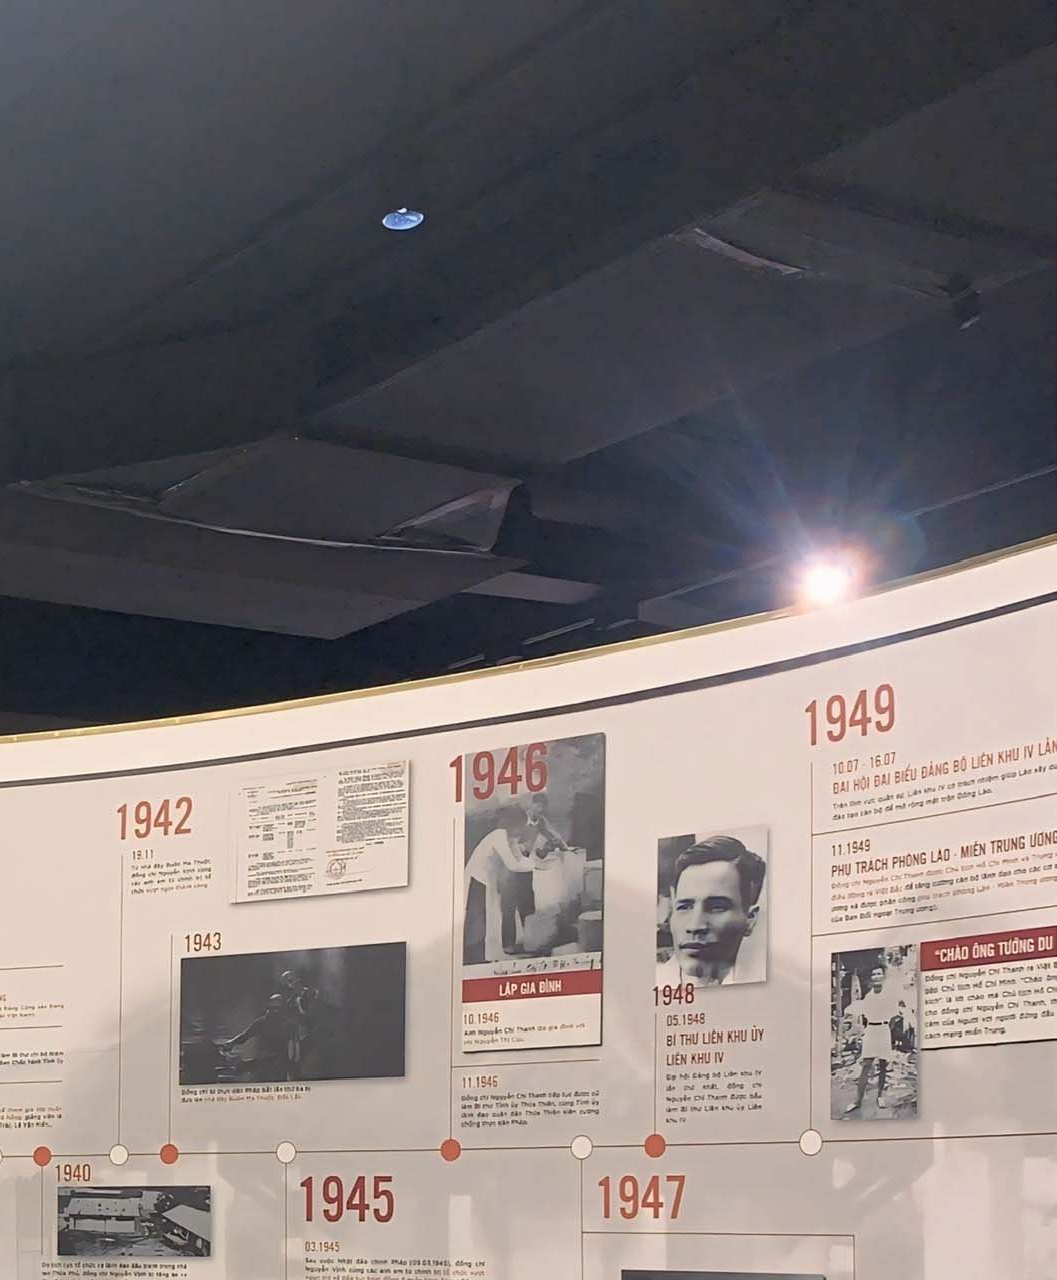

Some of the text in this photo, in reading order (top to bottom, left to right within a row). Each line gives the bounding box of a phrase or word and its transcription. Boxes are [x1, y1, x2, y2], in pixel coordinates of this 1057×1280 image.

[805, 683, 895, 746] 1949
[833, 759, 859, 775] 10.07
[870, 752, 896, 769] 16.07
[971, 752, 994, 769] LIÊN
[998, 747, 1020, 764] KHU
[1024, 744, 1034, 759] IV
[449, 742, 548, 803] 1946
[116, 796, 193, 841] 1942
[832, 839, 871, 857] 11.1949
[990, 835, 1026, 854] TRUNG
[184, 932, 222, 953] 1943
[972, 942, 995, 959] ÔNG
[998, 936, 1035, 956] TƯỚNG
[1038, 935, 1054, 952] DU
[499, 978, 562, 997] LẬP GIA ĐÌNH
[652, 982, 694, 1007] 1948
[464, 1012, 500, 1025] 10.1946
[666, 1012, 706, 1027] 05.1948
[666, 1024, 765, 1047] BÍ THƯ LIÊN KHU ỦY
[666, 1051, 725, 1066] LIÊN KHU IV
[462, 1075, 498, 1088] 11.1946
[55, 1164, 91, 1182] 1940
[300, 1175, 395, 1223] 1945
[598, 1175, 686, 1220] 1947
[304, 1240, 341, 1252] 03.1945
